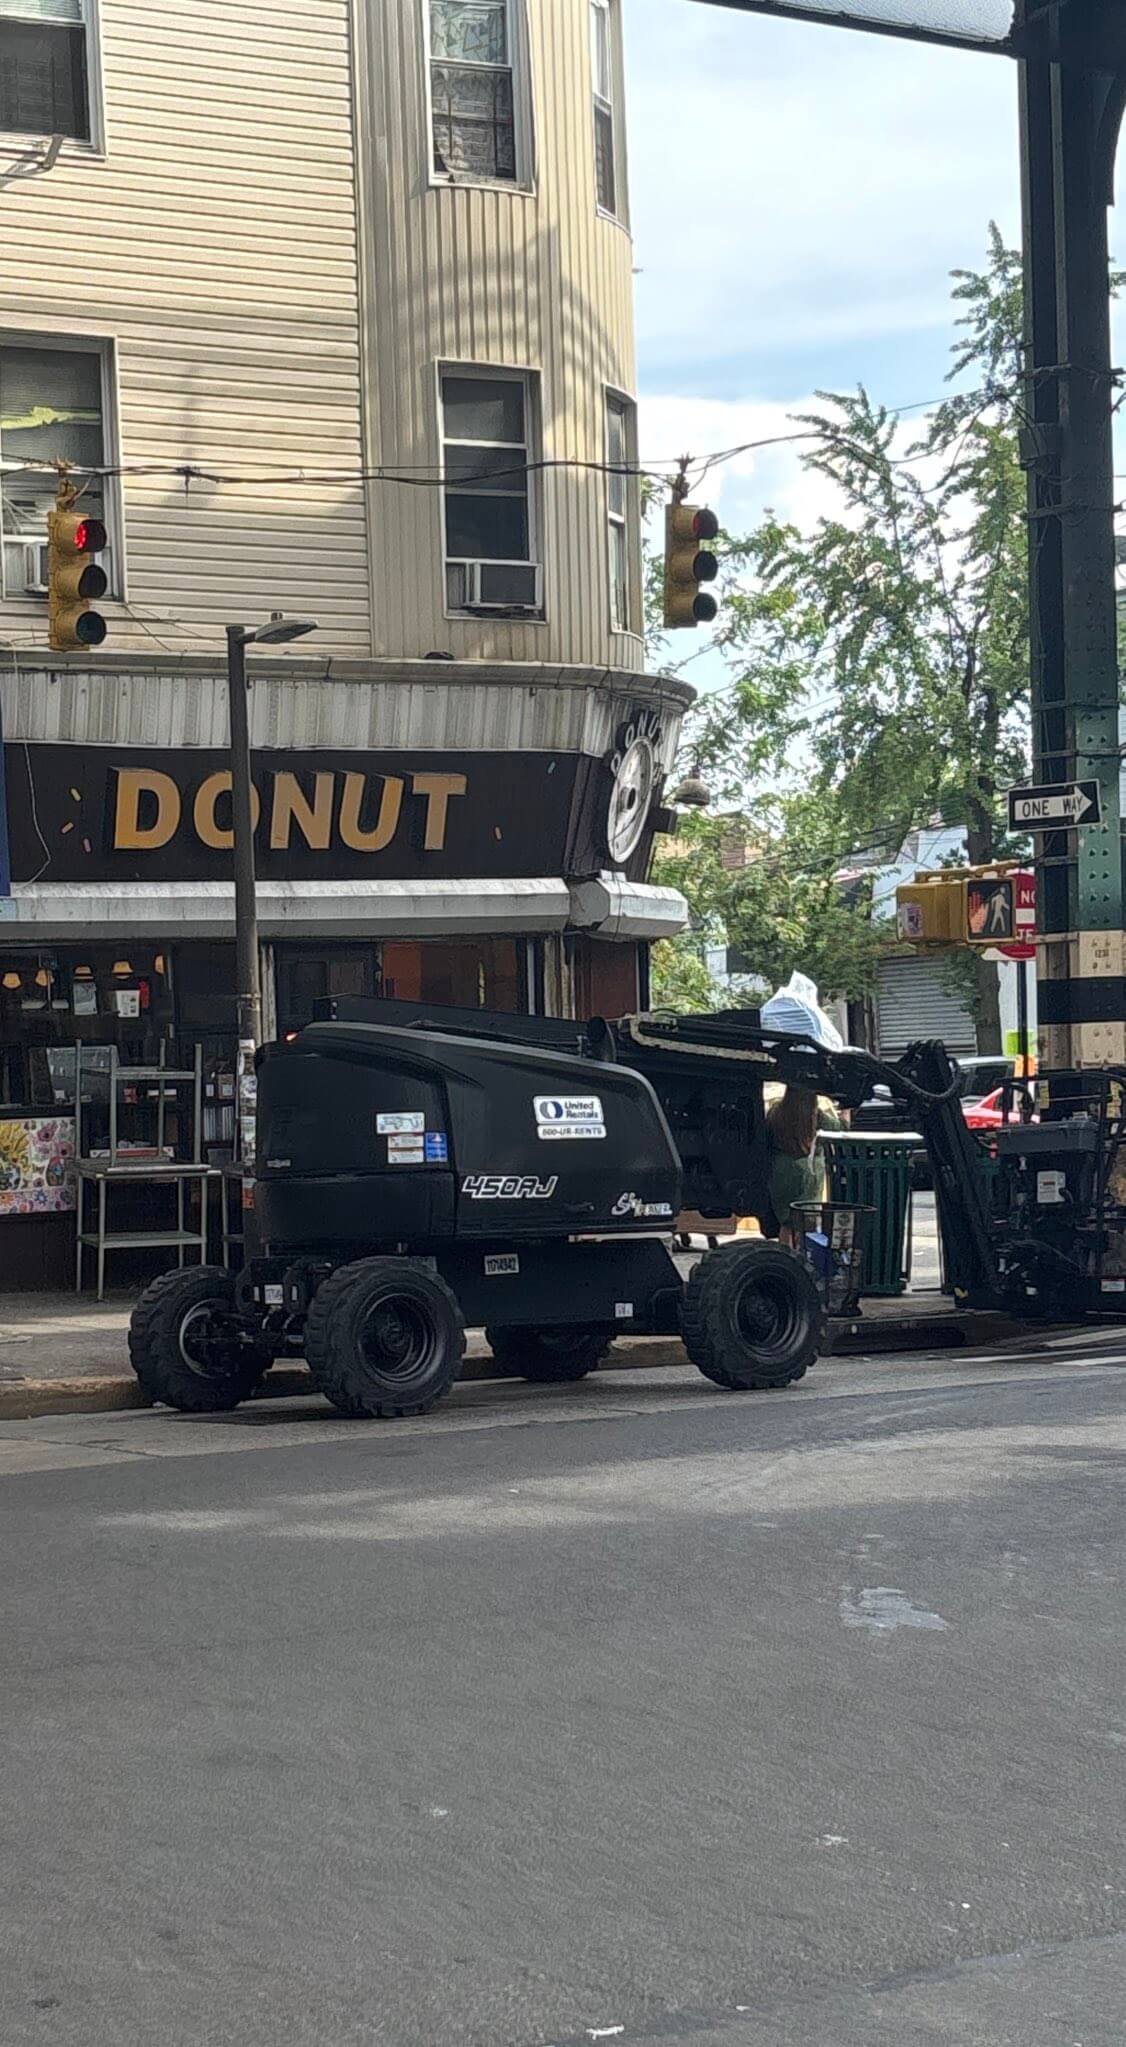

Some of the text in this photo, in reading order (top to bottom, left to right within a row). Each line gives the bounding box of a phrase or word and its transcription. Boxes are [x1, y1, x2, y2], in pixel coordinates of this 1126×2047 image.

[114, 767, 467, 852] DONUT
[1022, 796, 1084, 817] ONE WAY
[564, 1101, 594, 1110] United
[566, 1110, 599, 1119] Rentals
[461, 1175, 559, 1199] 450AJ
